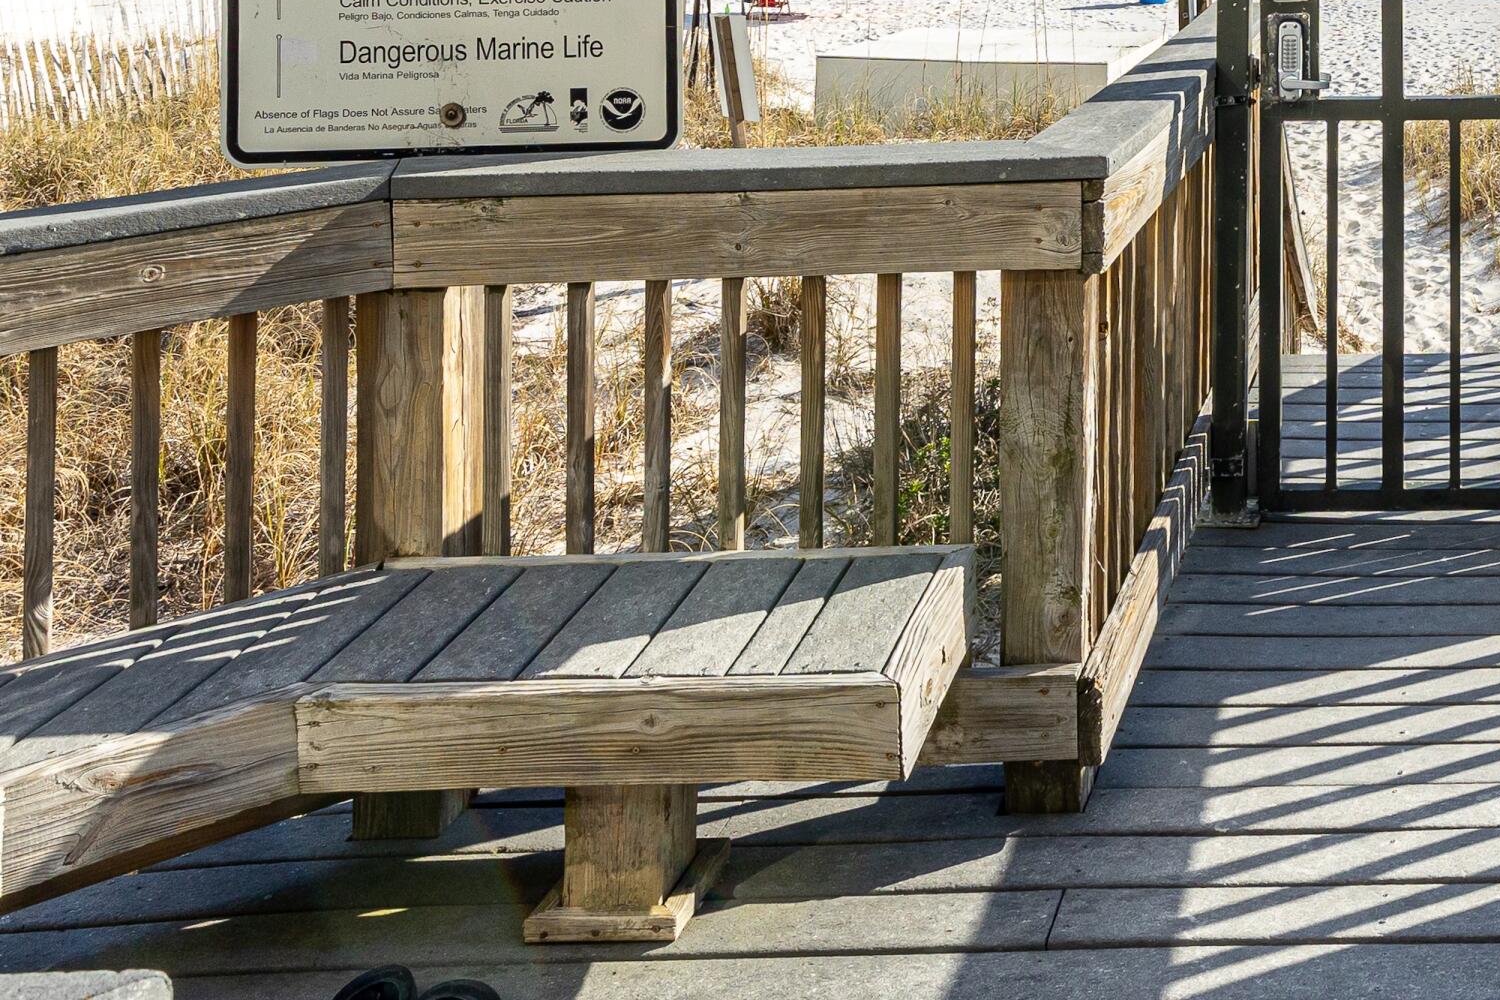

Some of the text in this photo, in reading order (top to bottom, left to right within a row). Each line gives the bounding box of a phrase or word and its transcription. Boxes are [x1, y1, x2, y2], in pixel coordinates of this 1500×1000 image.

[338, 12, 369, 22] Peligro
[396, 11, 451, 20] Condiciones
[493, 9, 520, 19] Tenga
[522, 8, 560, 17] Cuidado
[340, 34, 603, 67] Dangerous Marine Life
[339, 69, 440, 81] Vida Marina Peligrosa
[254, 107, 425, 120] Absence of Flags Does Not Assure
[264, 126, 274, 134] La
[328, 124, 365, 132] Banderas
[368, 123, 379, 131] No
